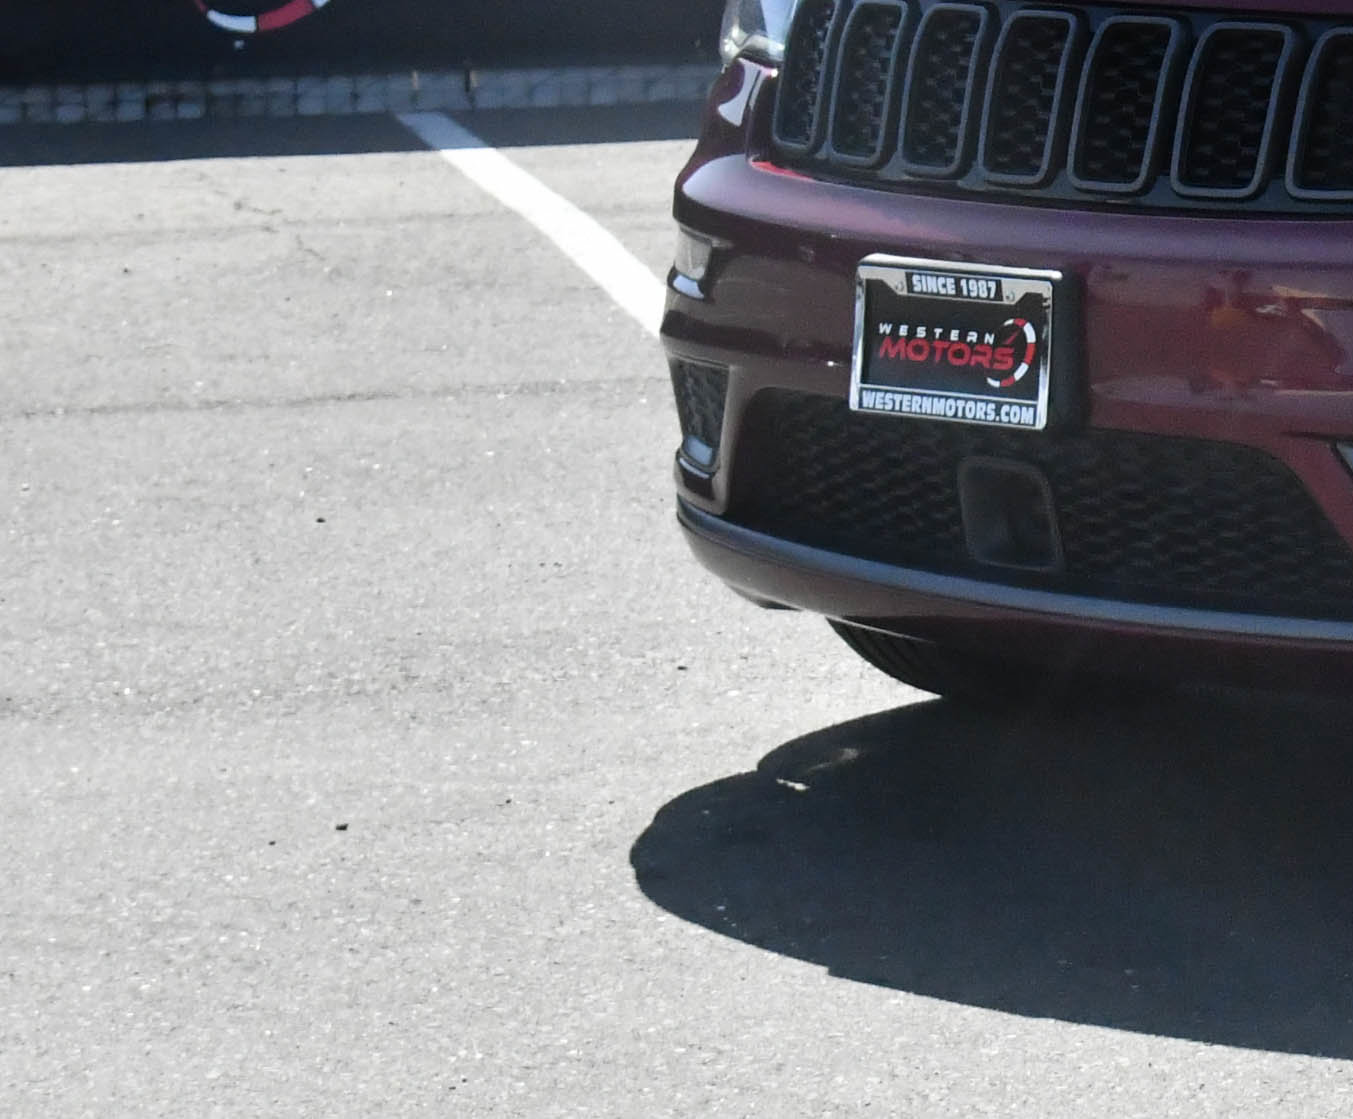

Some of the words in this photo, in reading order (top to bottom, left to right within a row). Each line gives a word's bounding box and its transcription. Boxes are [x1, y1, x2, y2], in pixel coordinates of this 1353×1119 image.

[911, 274, 956, 294] SINCE
[960, 278, 997, 299] 1987
[878, 322, 996, 345] WESTERN
[878, 336, 1016, 370] MOTORS
[861, 390, 1035, 425] WESTERNMOTORS.COM
